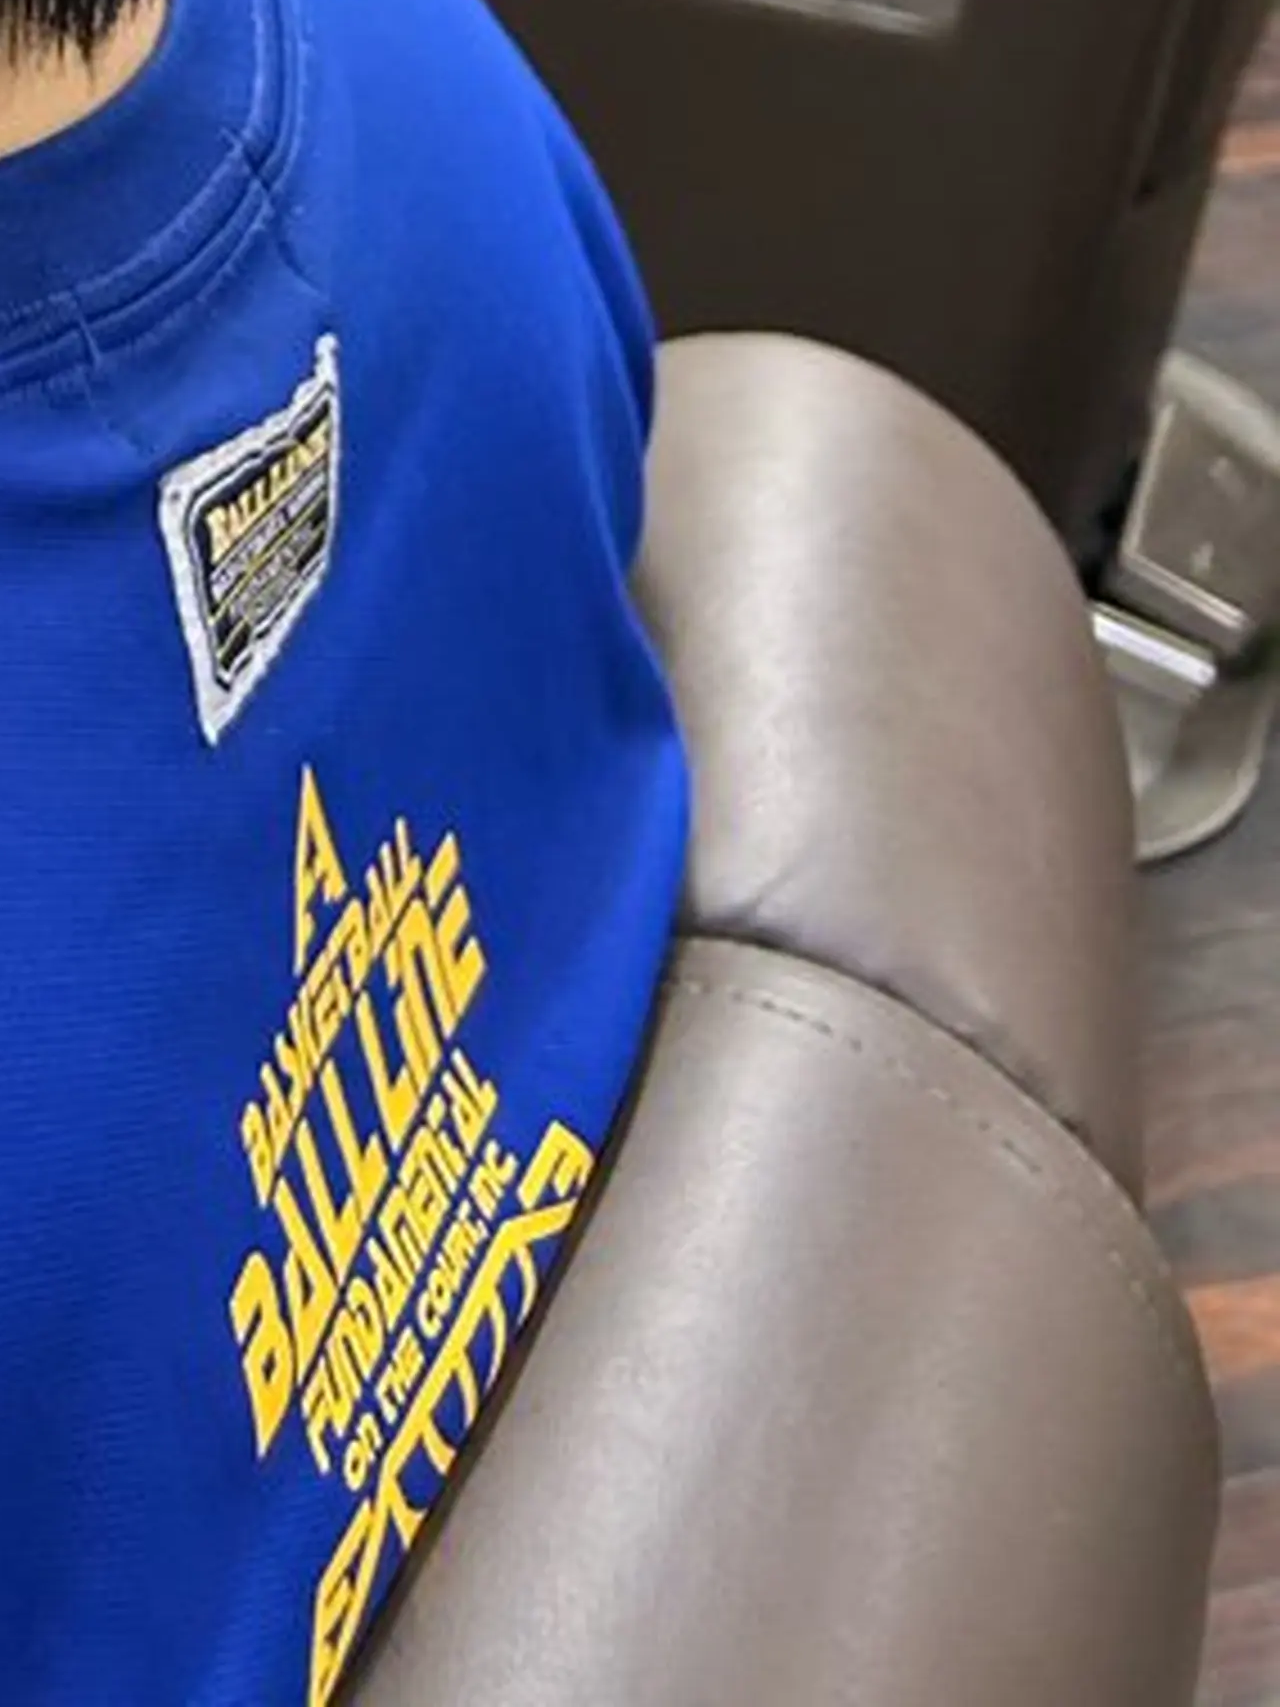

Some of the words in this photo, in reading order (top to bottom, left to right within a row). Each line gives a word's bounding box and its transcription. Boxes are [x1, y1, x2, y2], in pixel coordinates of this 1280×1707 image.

[240, 815, 421, 1209] BASKETBALL
[229, 1053, 390, 1457] BALL
[300, 1047, 498, 1475] FUNDAMENTAL
[375, 1325, 425, 1425] THE
